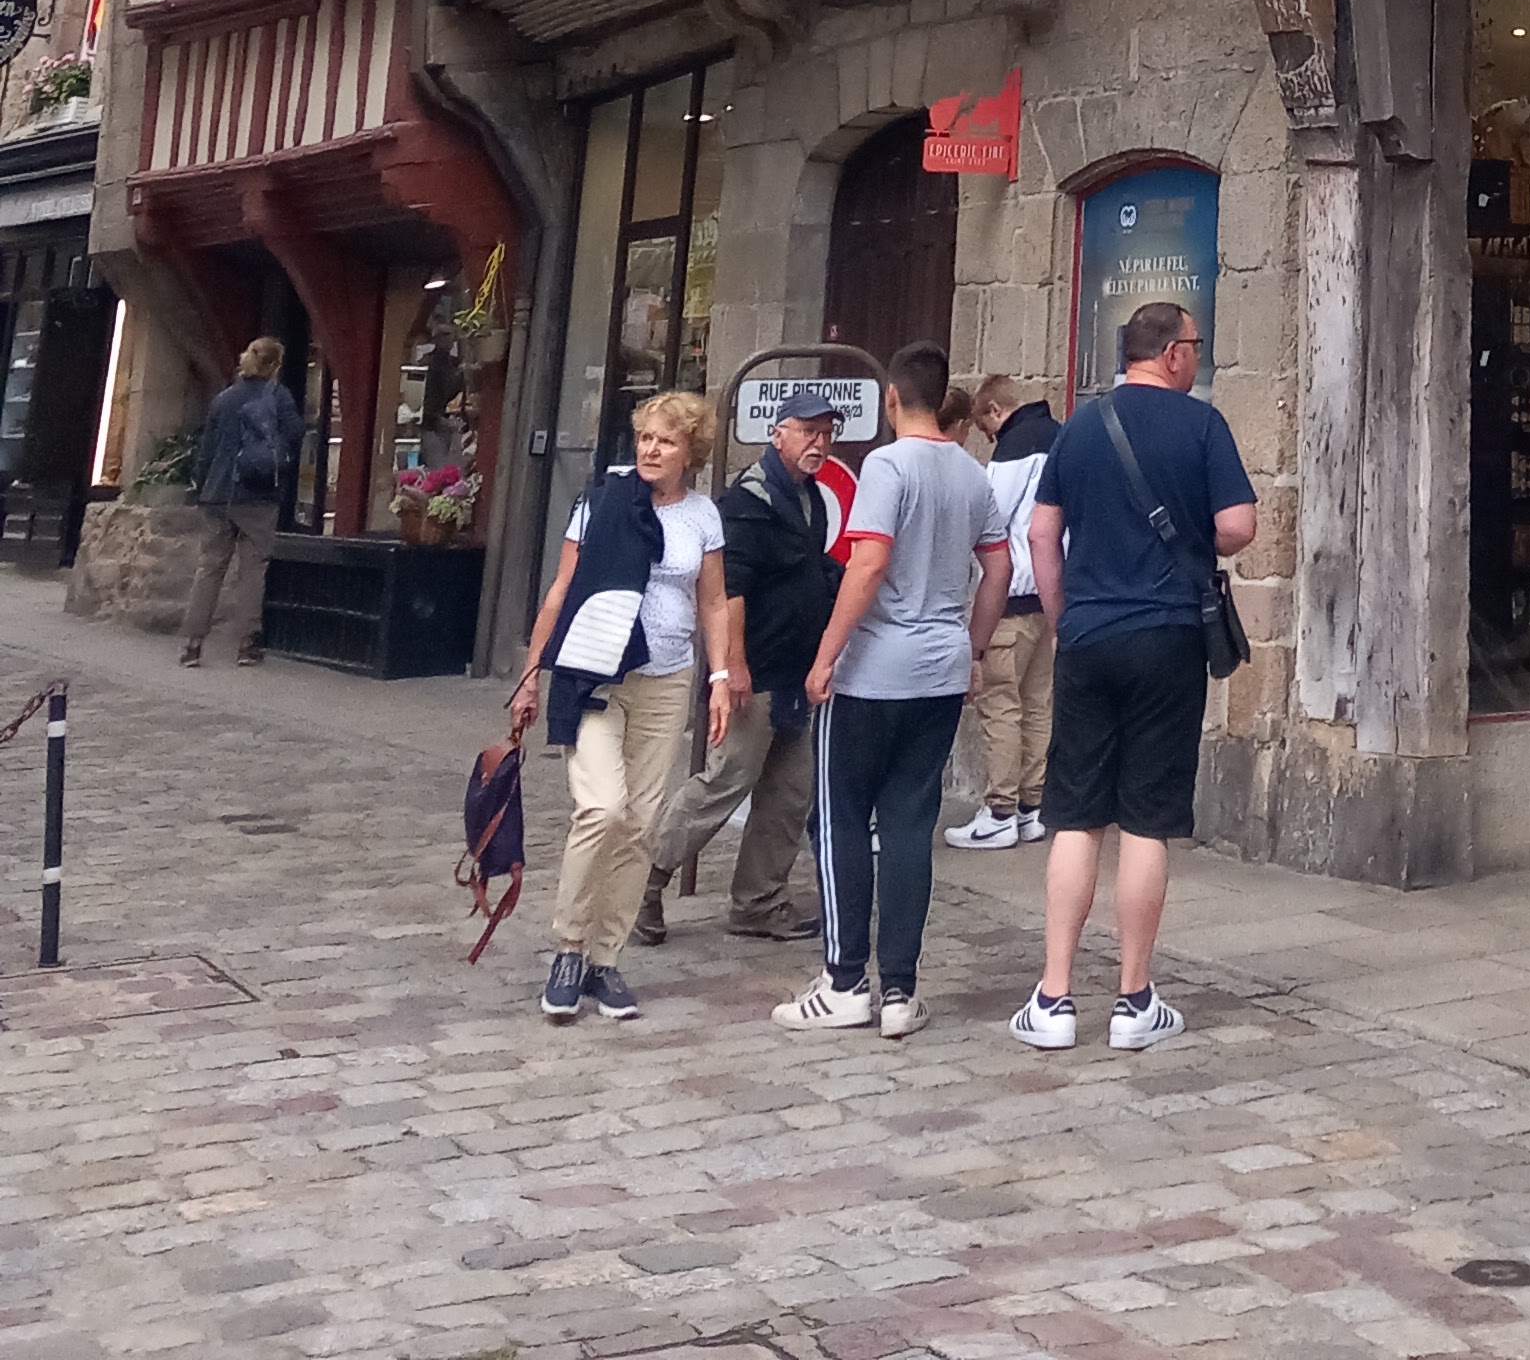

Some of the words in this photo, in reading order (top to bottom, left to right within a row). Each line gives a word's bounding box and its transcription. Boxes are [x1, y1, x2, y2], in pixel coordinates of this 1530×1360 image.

[929, 143, 977, 158] EPICERIE
[982, 145, 1005, 159] FINE
[1119, 256, 1133, 274] NÉ
[1133, 258, 1152, 273] PAR
[1153, 257, 1166, 271] LE
[1138, 278, 1156, 293] PAR
[1158, 277, 1170, 292] LE
[759, 383, 788, 401] RUE
[750, 405, 774, 419] DU
